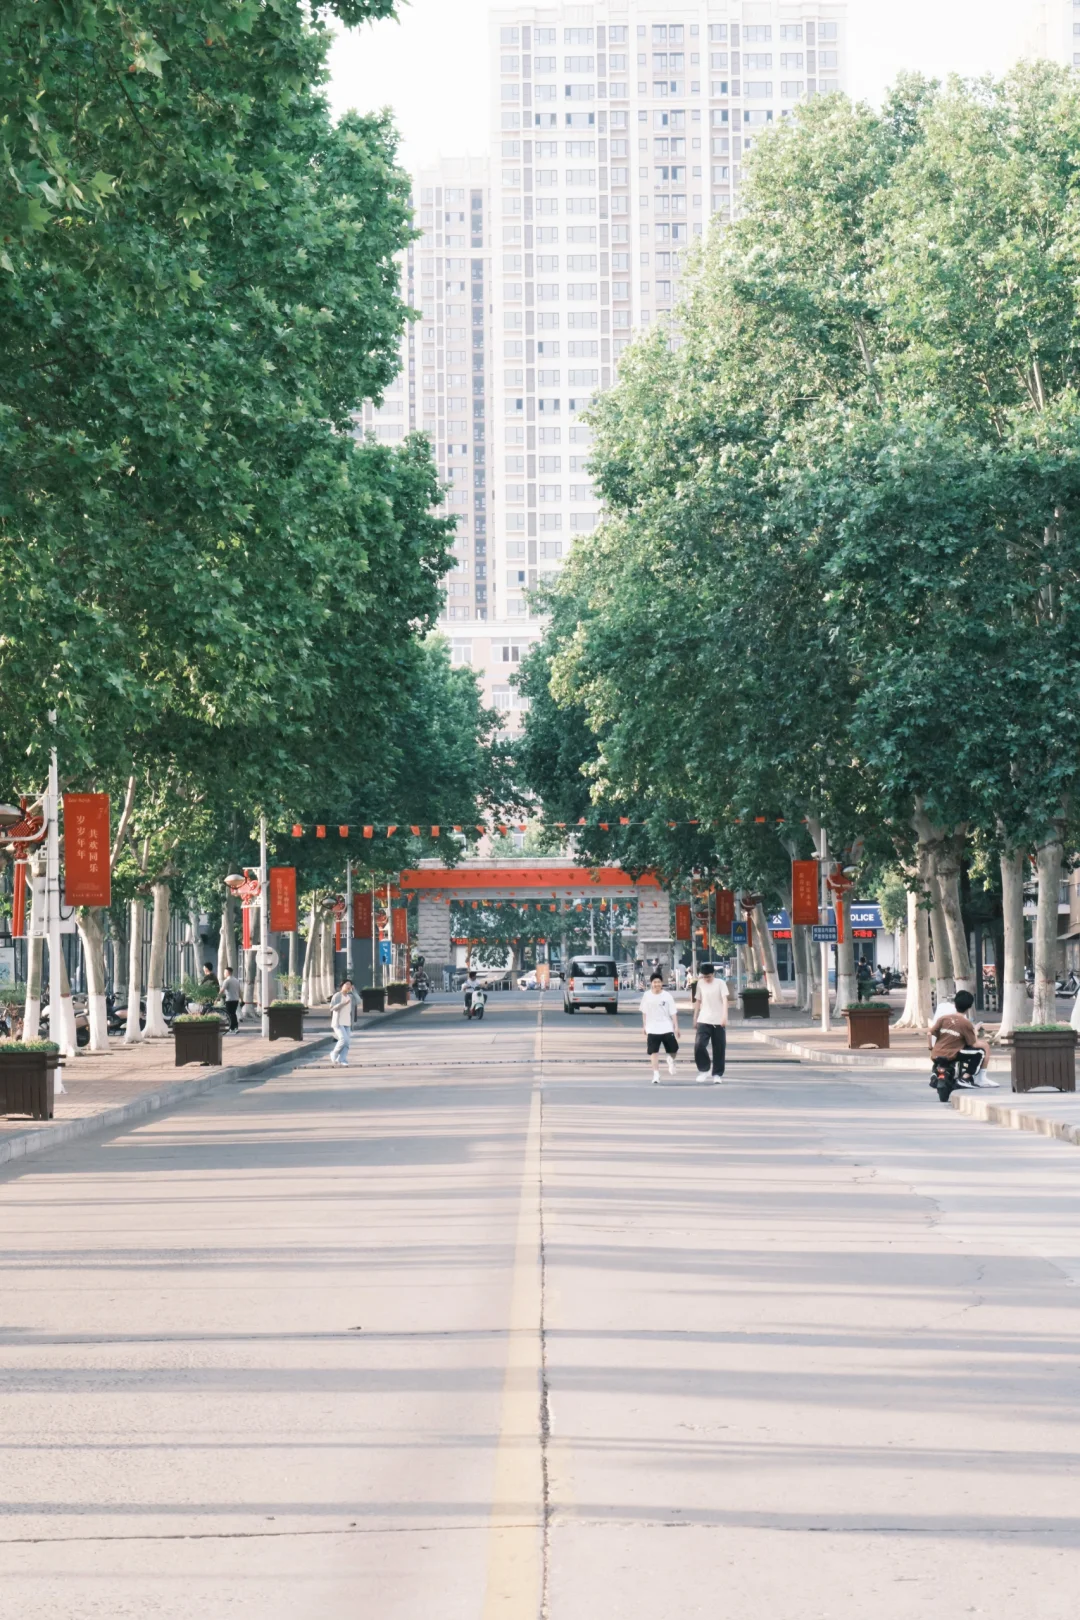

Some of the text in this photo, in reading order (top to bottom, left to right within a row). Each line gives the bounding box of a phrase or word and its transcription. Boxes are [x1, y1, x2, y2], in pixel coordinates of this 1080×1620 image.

[76, 816, 86, 860] 岁岁年年
[89, 829, 98, 872] 共欢同乐
[850, 913, 874, 922] OLICE
